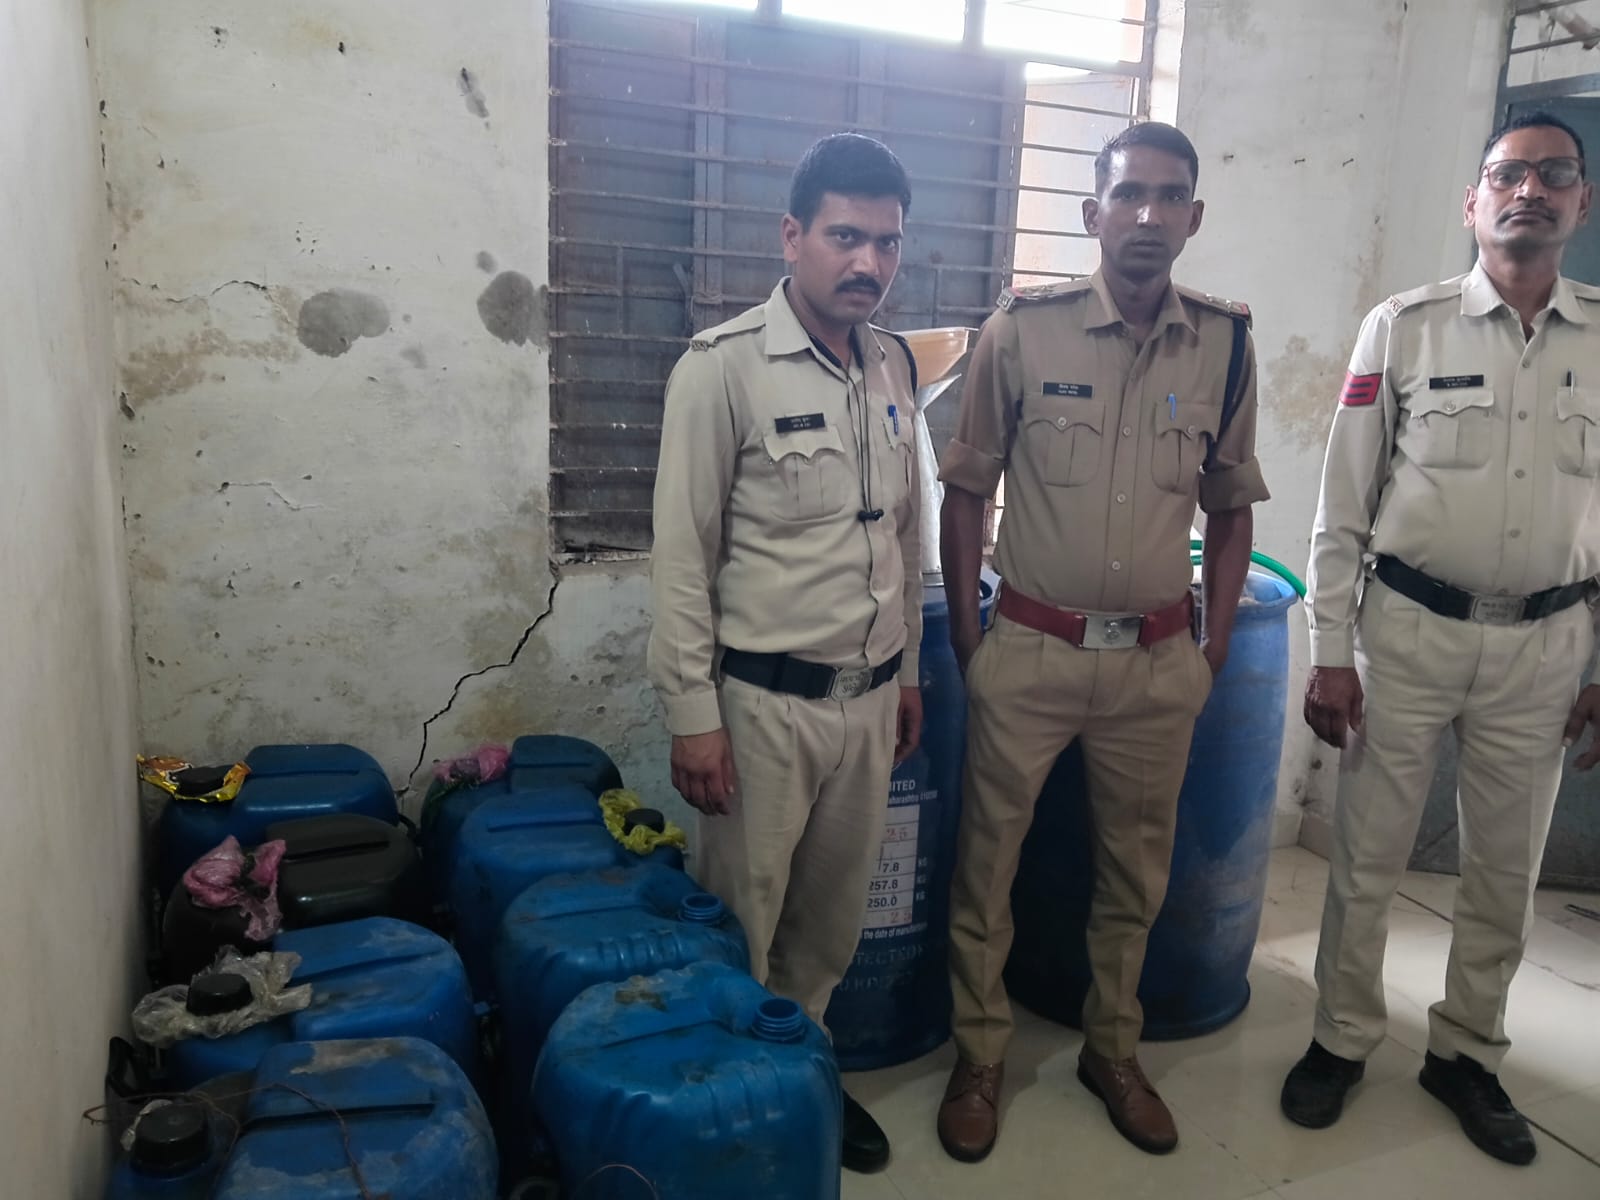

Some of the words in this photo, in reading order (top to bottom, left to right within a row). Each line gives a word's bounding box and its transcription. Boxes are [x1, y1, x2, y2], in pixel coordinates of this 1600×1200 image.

[888, 779, 916, 793] ITED
[868, 879, 898, 891] 257.8
[867, 895, 898, 908] 250.0
